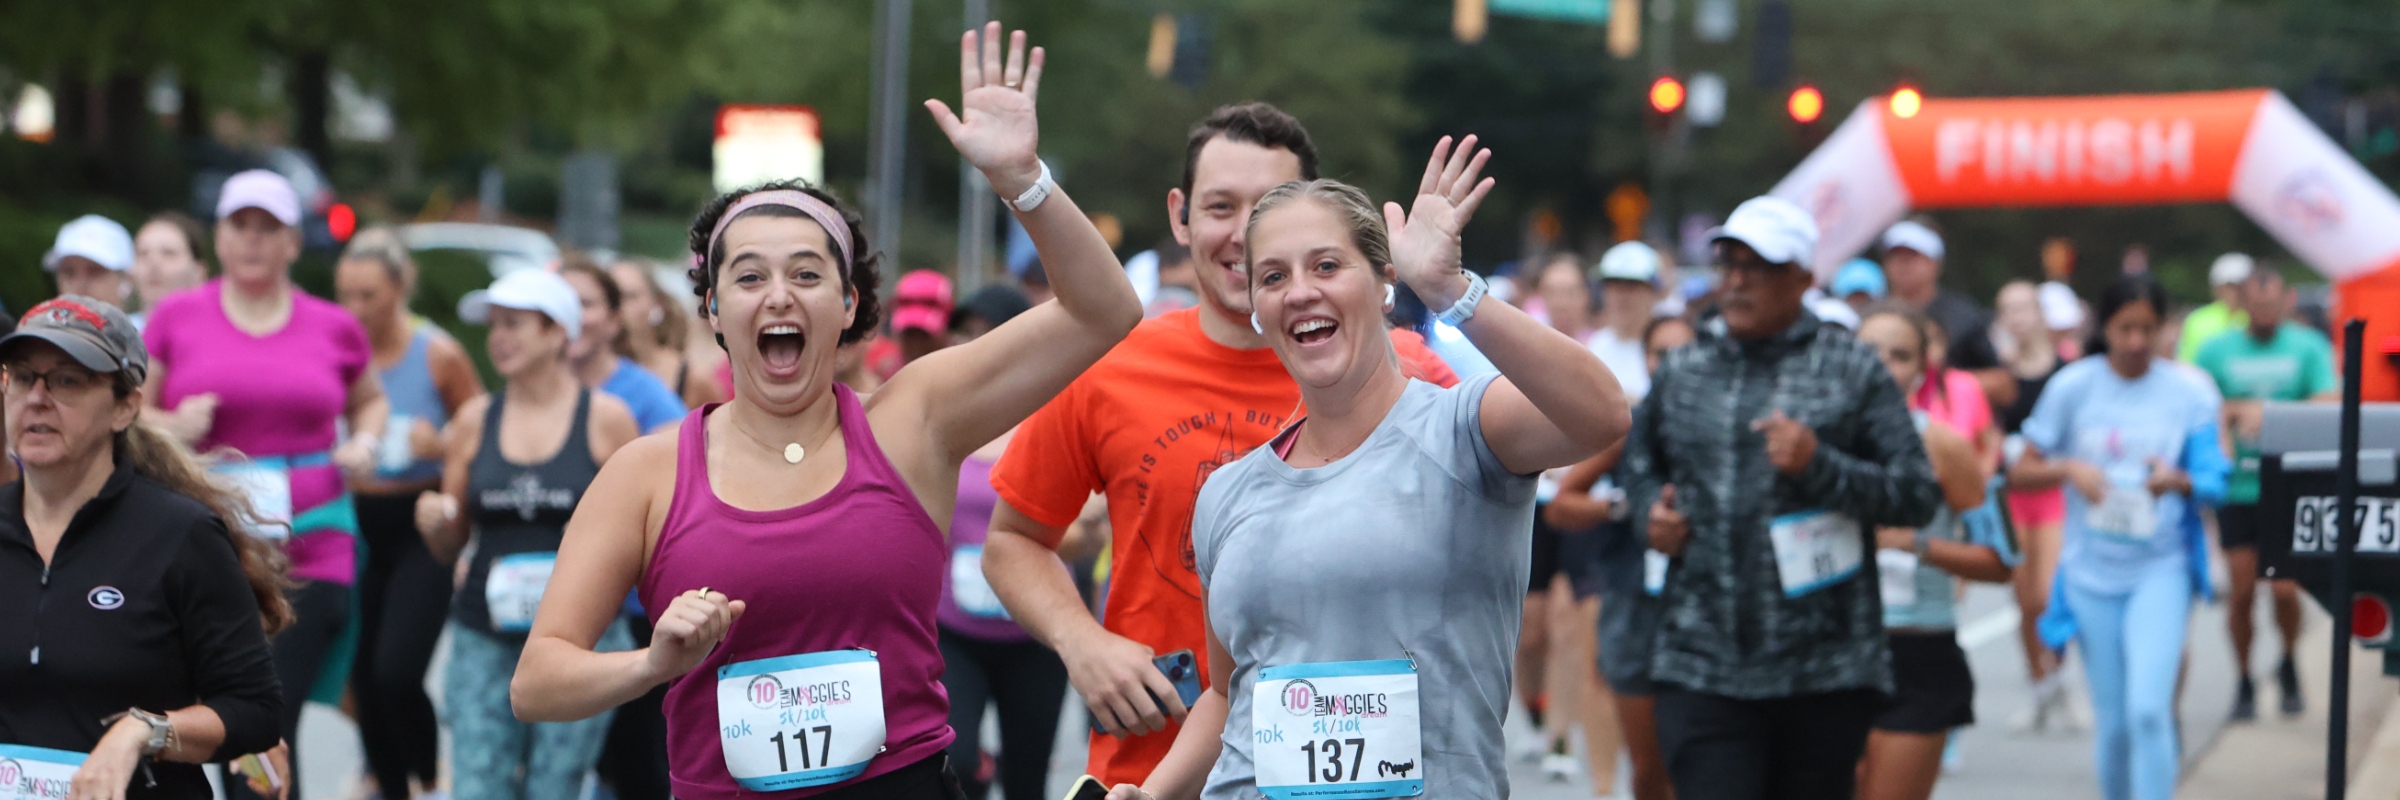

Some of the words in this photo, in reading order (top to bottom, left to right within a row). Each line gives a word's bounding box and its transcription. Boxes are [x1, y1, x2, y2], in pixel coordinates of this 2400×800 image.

[1934, 117, 2194, 187] FINISH
[1139, 452, 1157, 474] IS
[1155, 411, 1216, 450] TOUGH
[1246, 410, 1284, 430] BUT
[2300, 504, 2394, 545] 9375
[780, 688, 792, 710] TEAM
[1313, 696, 1326, 718] TEAM
[770, 725, 832, 772] 117
[1301, 738, 1365, 783] 137
